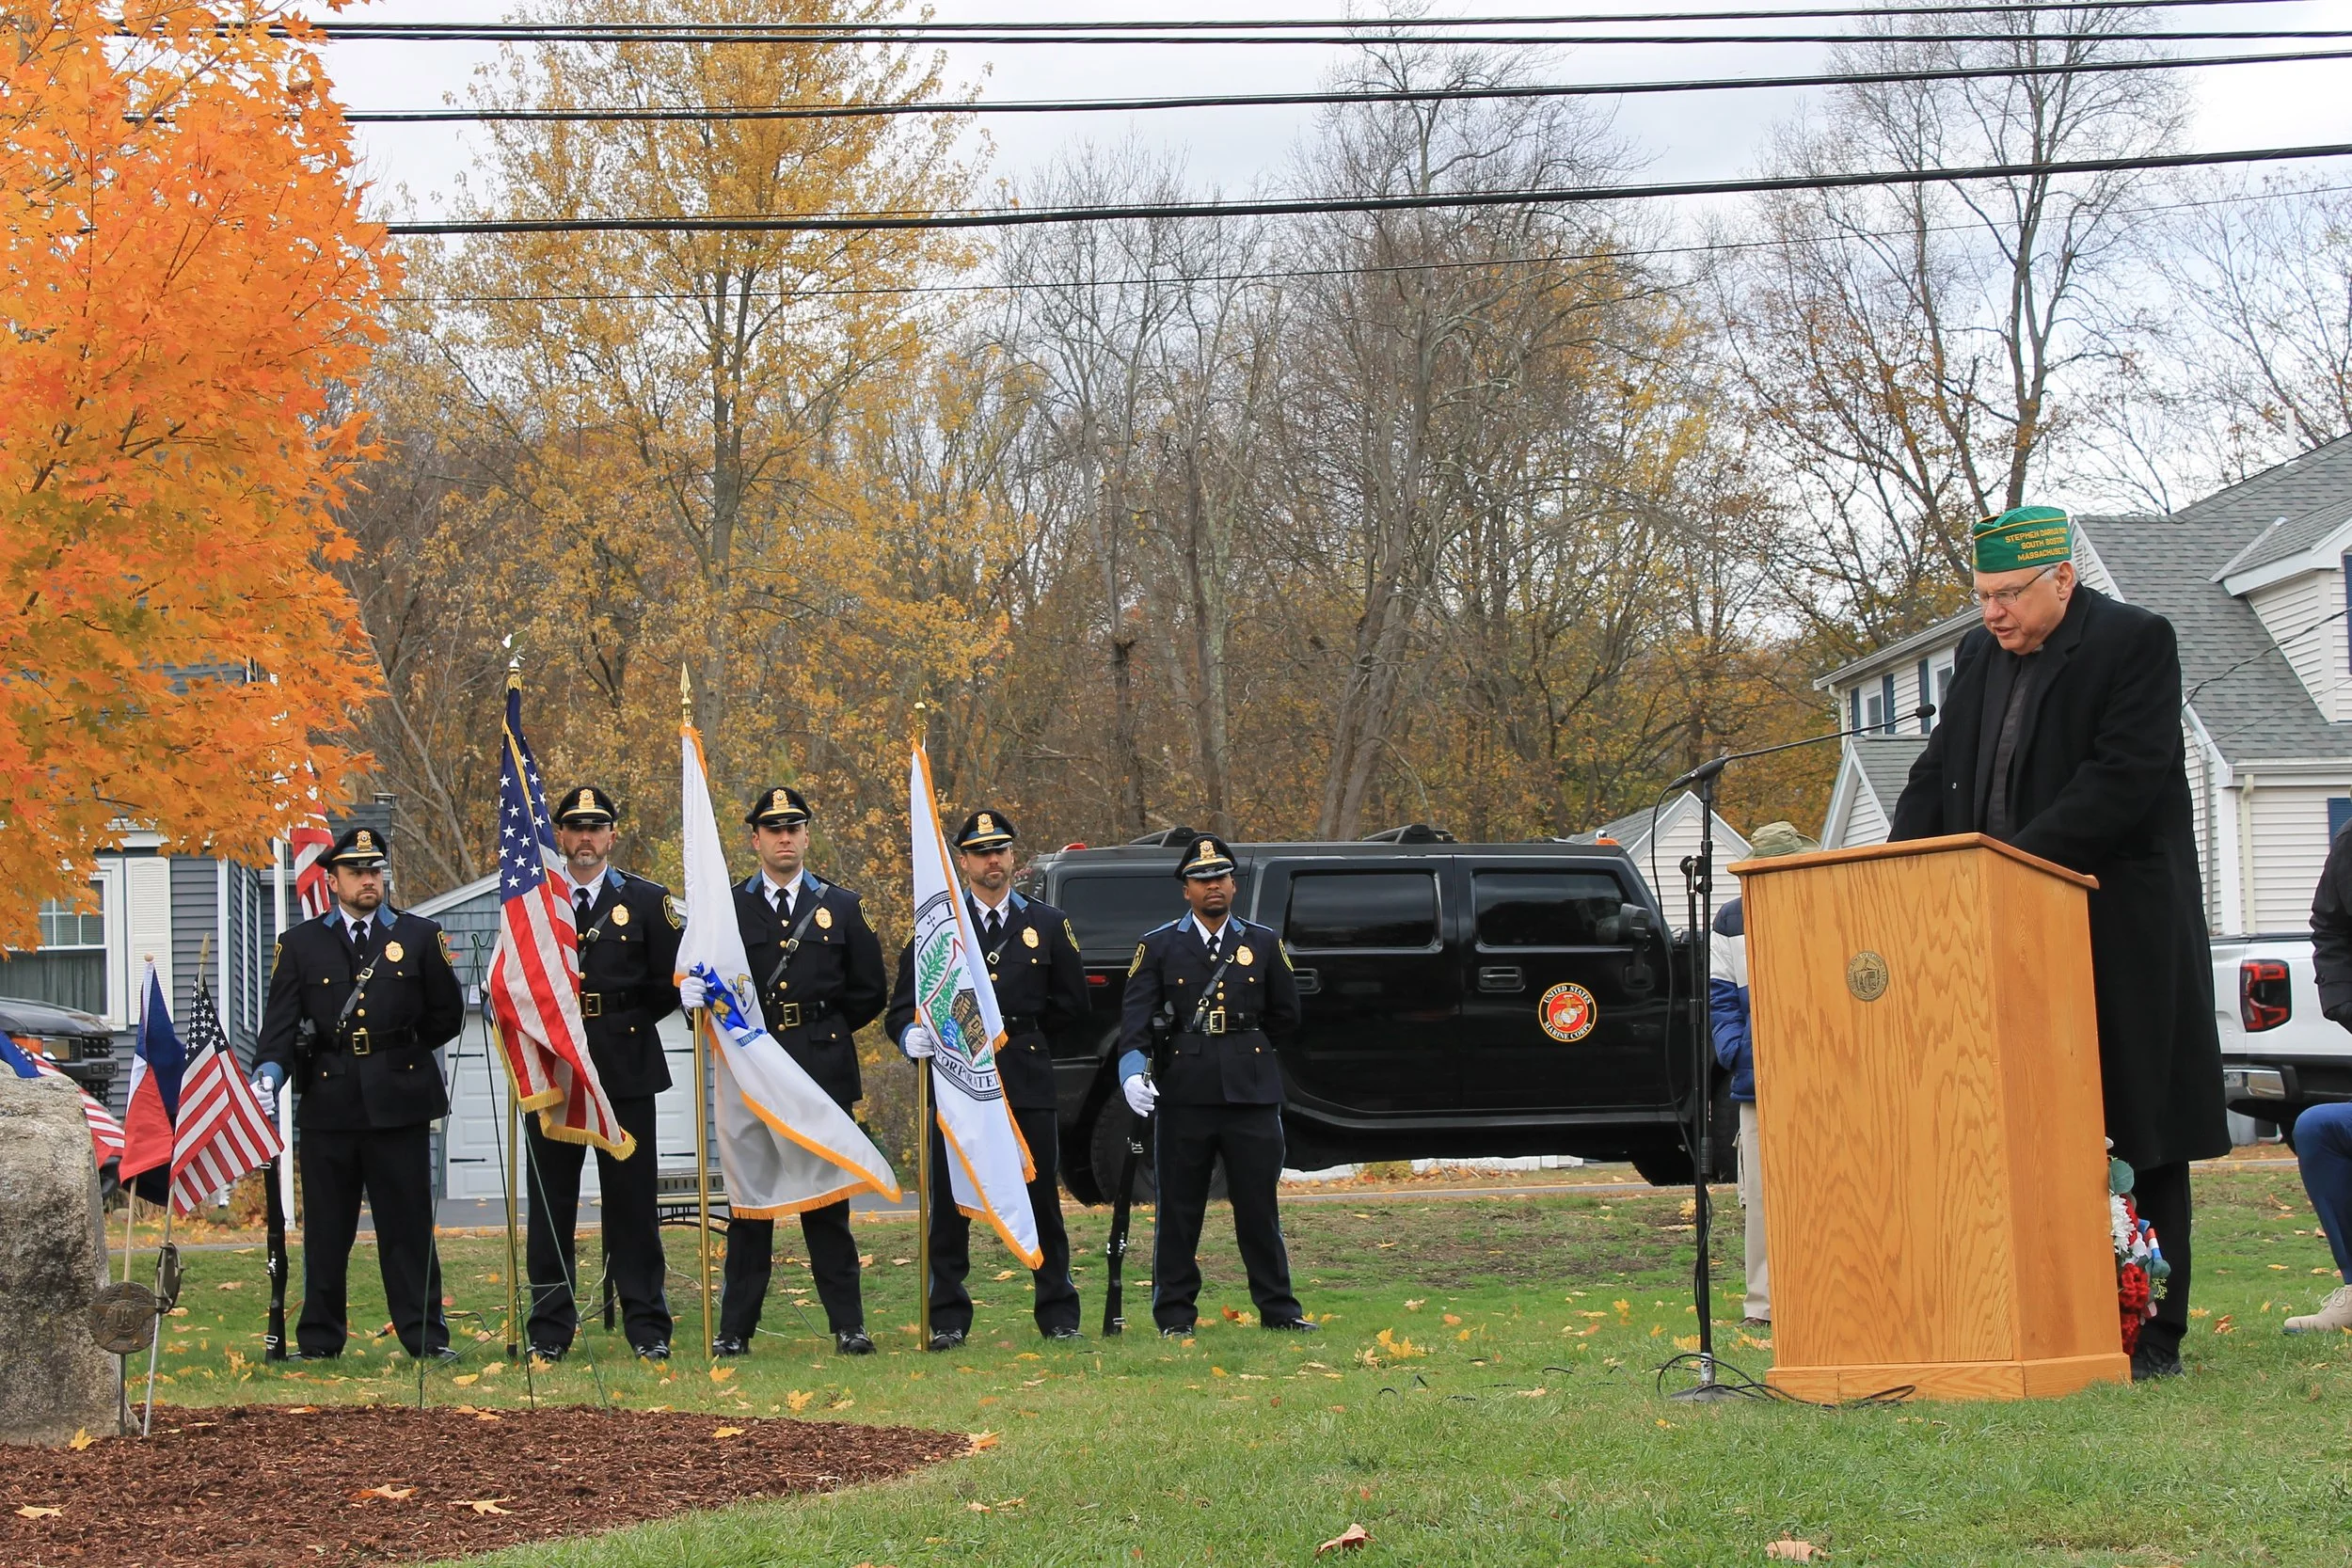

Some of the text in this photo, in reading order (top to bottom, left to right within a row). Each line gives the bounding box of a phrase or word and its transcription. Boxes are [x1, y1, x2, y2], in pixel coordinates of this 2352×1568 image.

[2005, 530, 2040, 544] STEPHEN
[2020, 537, 2066, 550] SOUTH BOSTON
[1543, 985, 1593, 1005] UNITED STATES
[1543, 1021, 1592, 1039] MARINE CORPS
